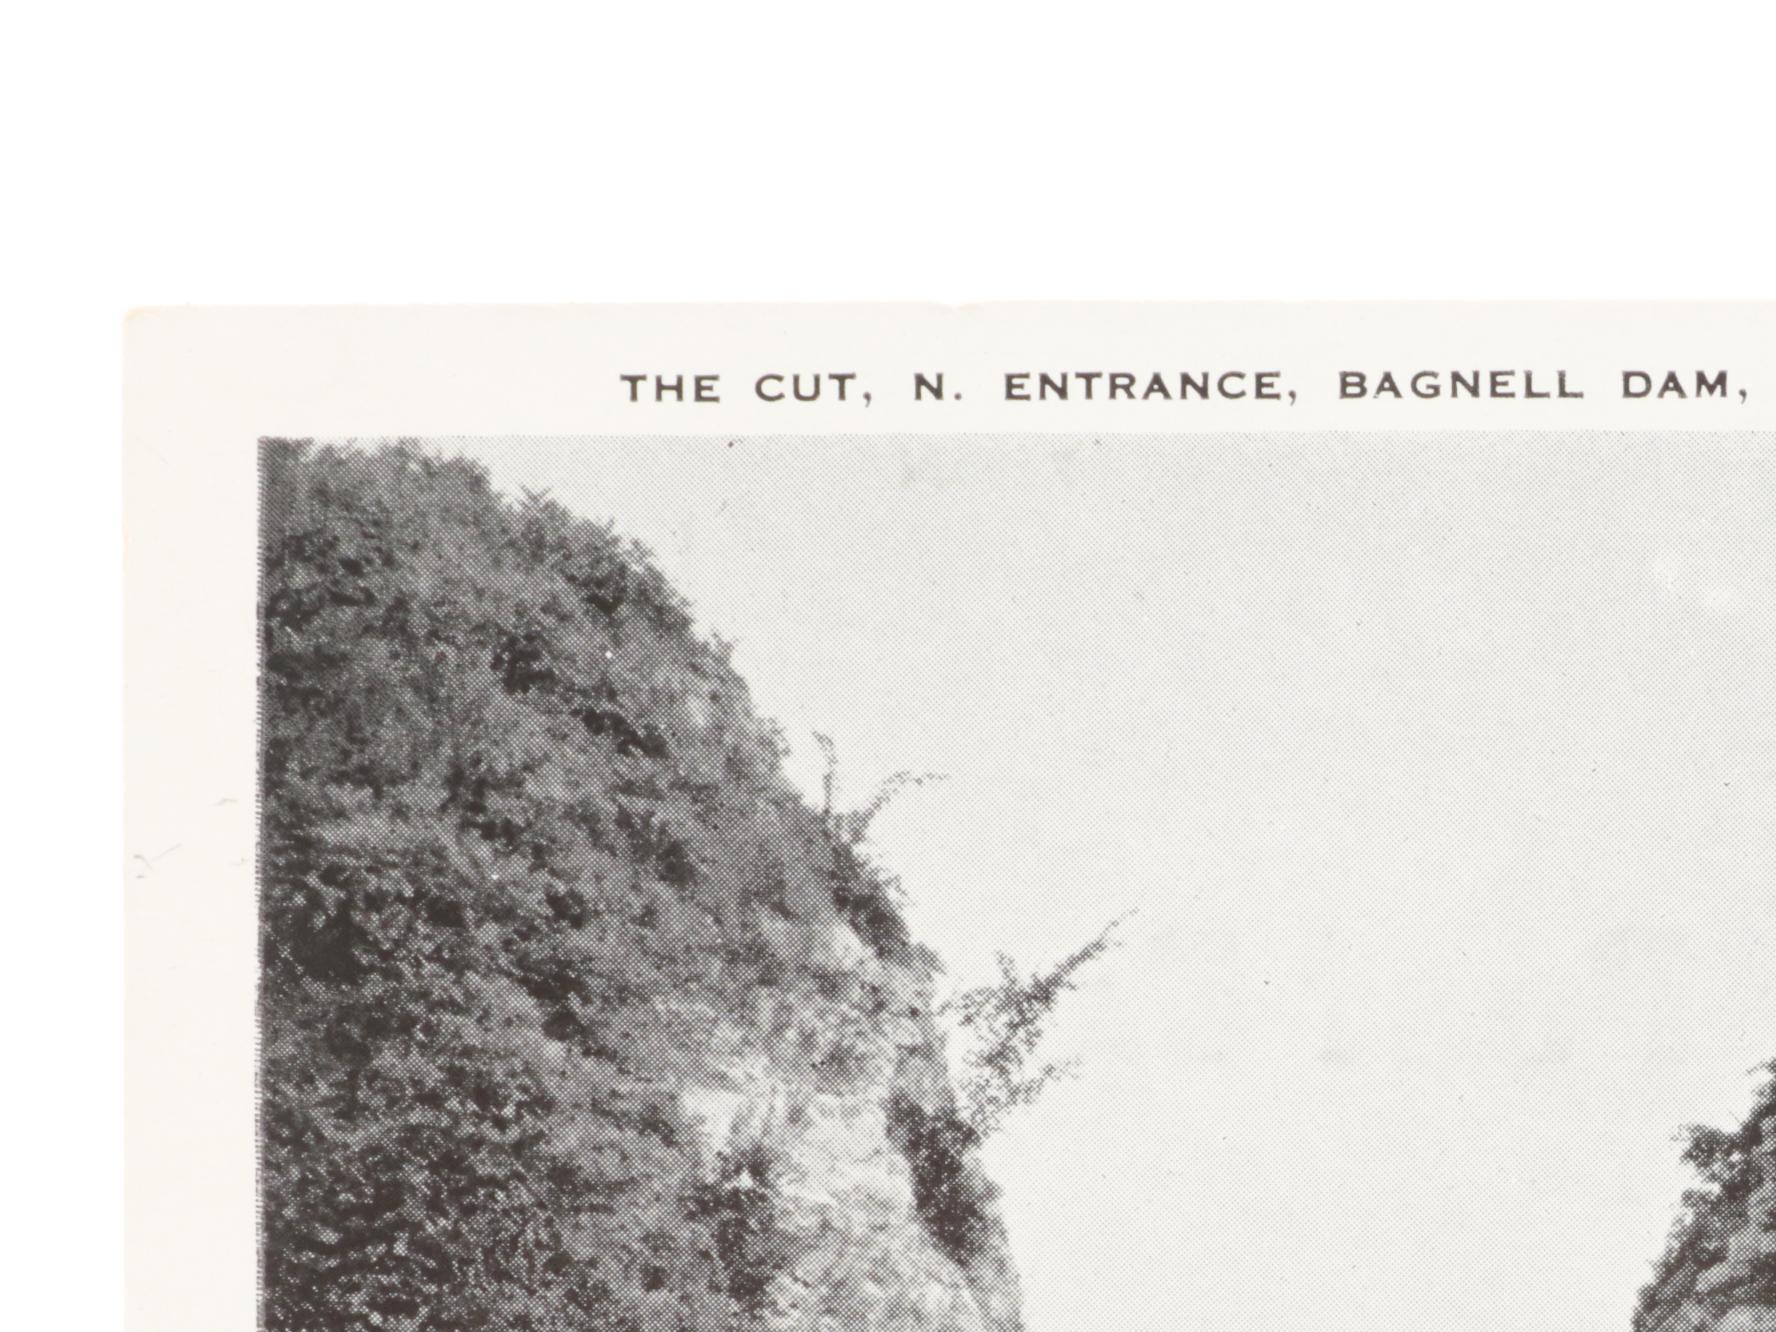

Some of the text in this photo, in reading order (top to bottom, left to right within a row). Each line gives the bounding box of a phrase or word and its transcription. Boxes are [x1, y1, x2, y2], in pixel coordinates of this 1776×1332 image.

[622, 376, 718, 401] THE
[756, 374, 870, 405] CUT,
[916, 374, 960, 399] N.
[1006, 372, 1295, 402] ENTRANCE,
[1341, 372, 1582, 398] BAGNELL
[1624, 372, 1746, 402] DAM,
